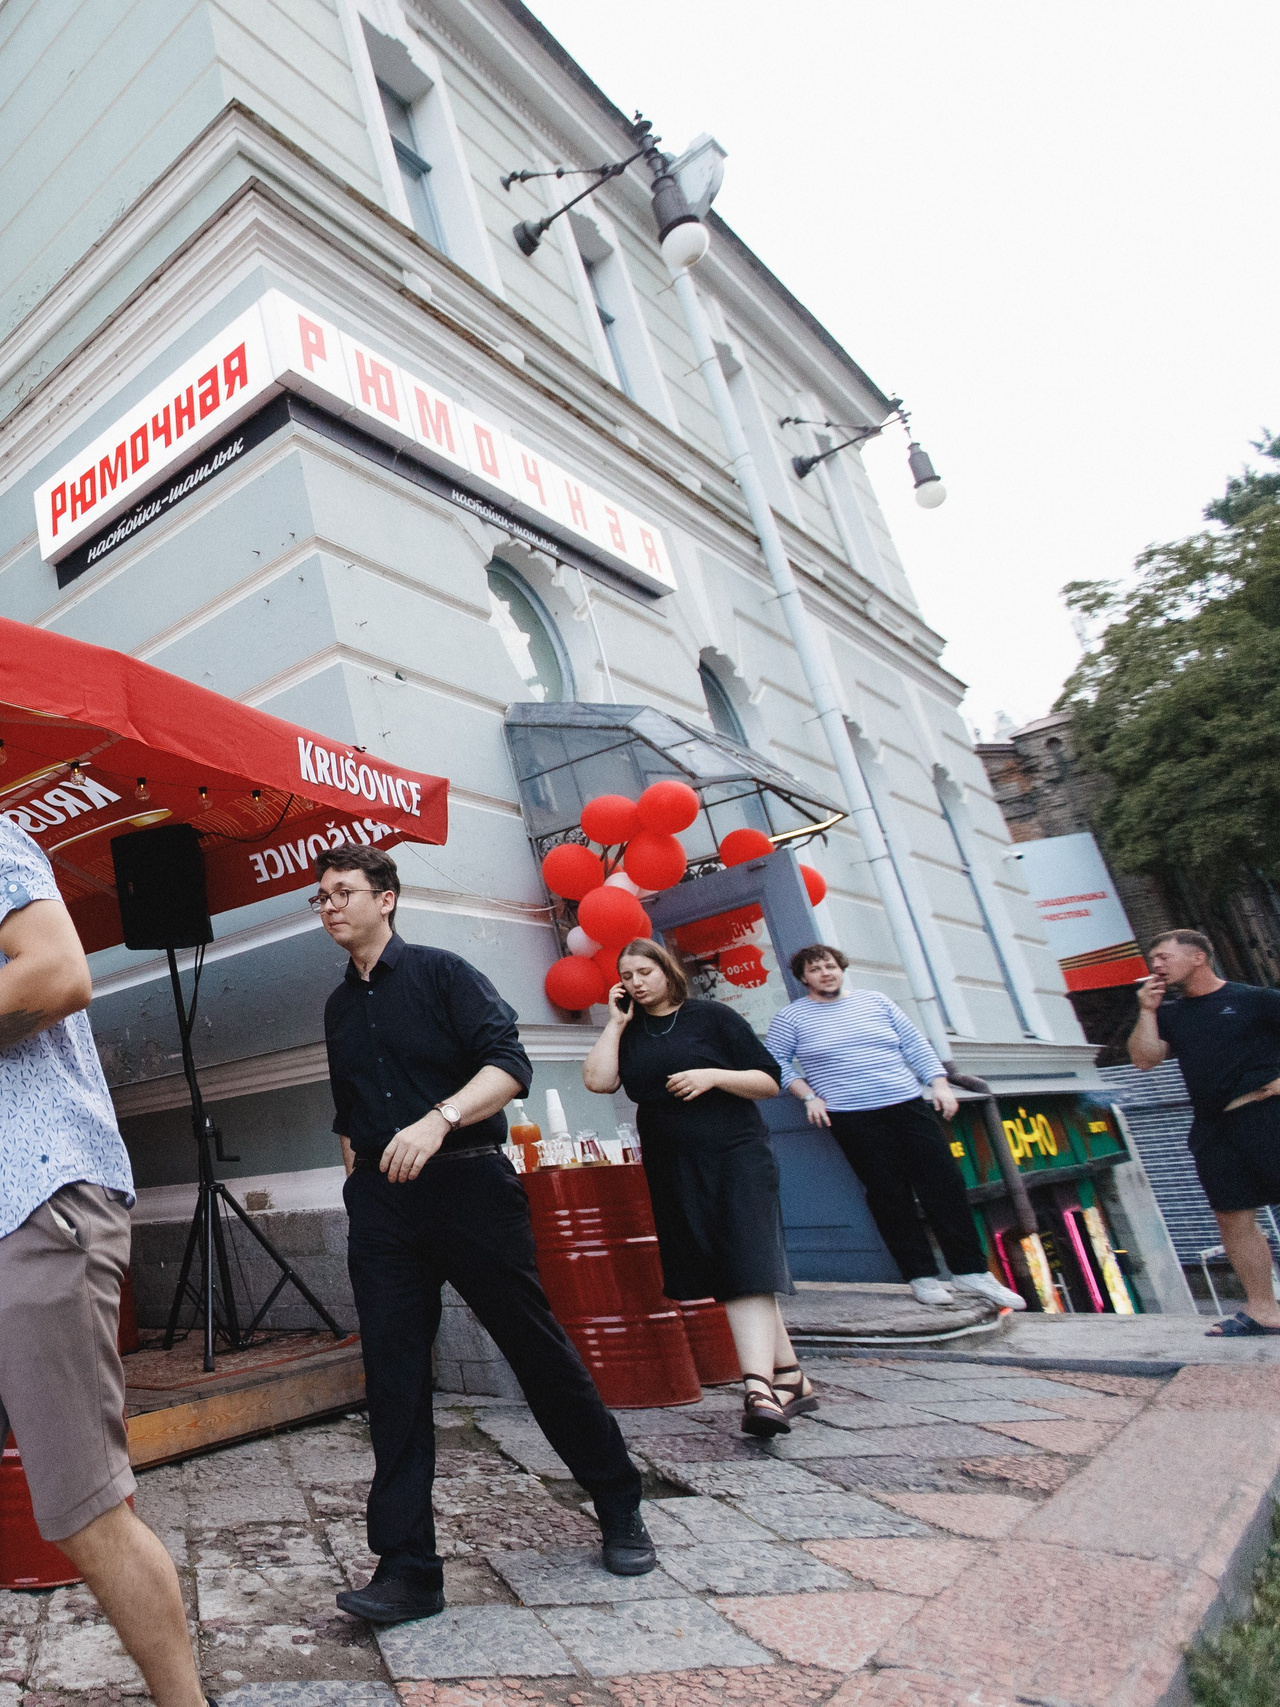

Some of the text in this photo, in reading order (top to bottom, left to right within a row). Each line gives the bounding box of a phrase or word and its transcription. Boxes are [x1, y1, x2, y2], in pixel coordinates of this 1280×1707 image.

[87, 437, 244, 563] настойки-шашлык
[451, 489, 560, 555] настойки-шашлык
[299, 737, 423, 818] KRUŠOVICE
